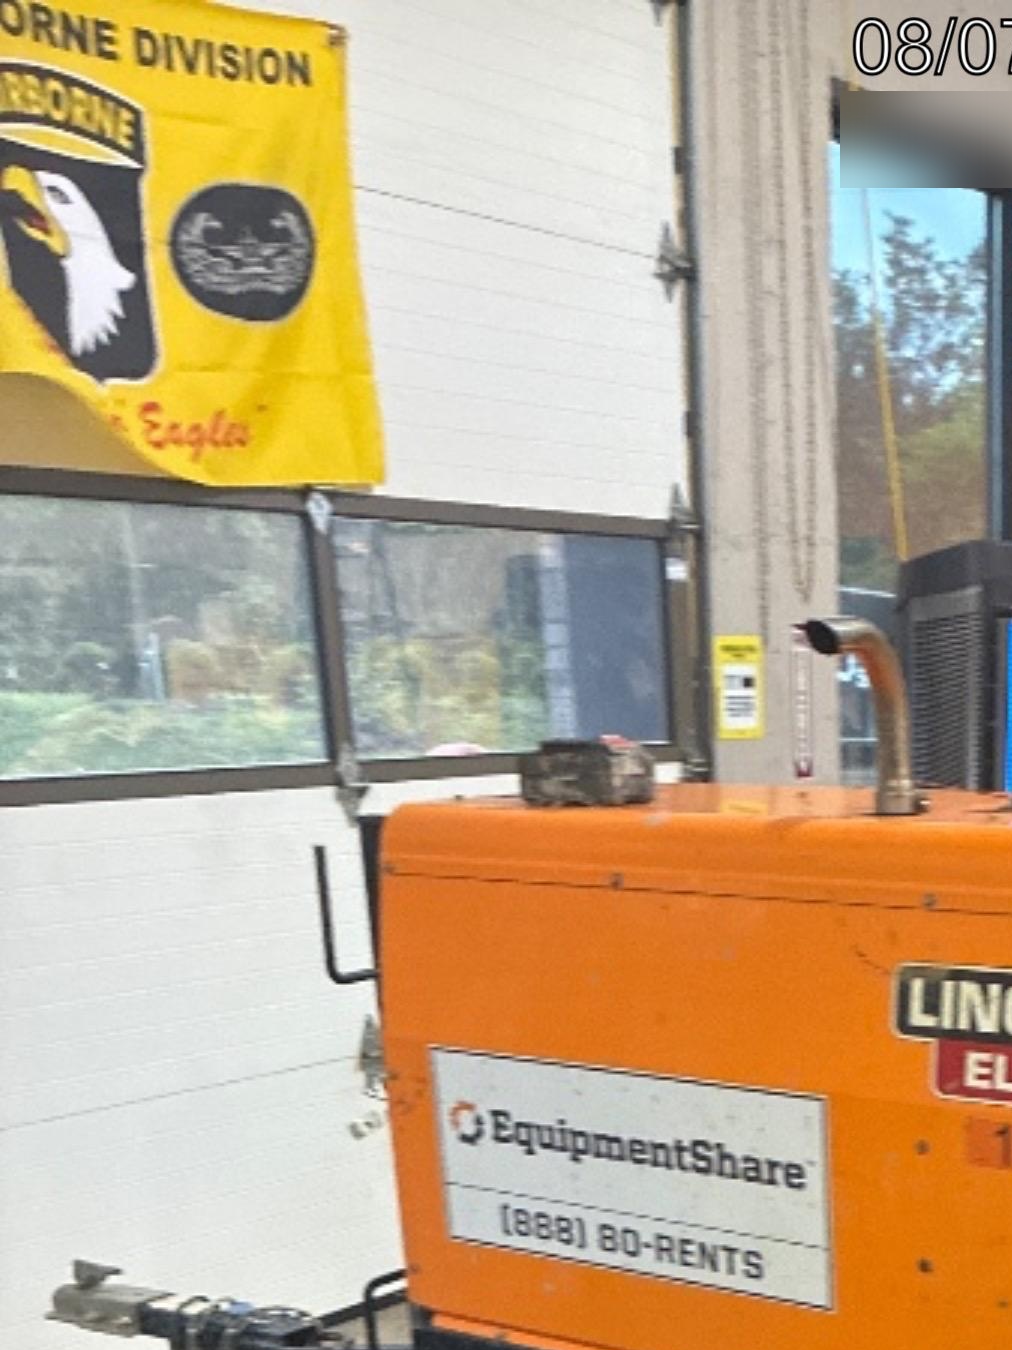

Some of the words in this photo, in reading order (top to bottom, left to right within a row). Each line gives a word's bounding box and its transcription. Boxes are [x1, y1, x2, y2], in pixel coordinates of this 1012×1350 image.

[134, 29, 312, 87] DIVISION
[490, 1109, 807, 1190] EquipmentShare
[500, 1204, 587, 1250] (888)
[598, 1223, 765, 1281] 80-RENTS
